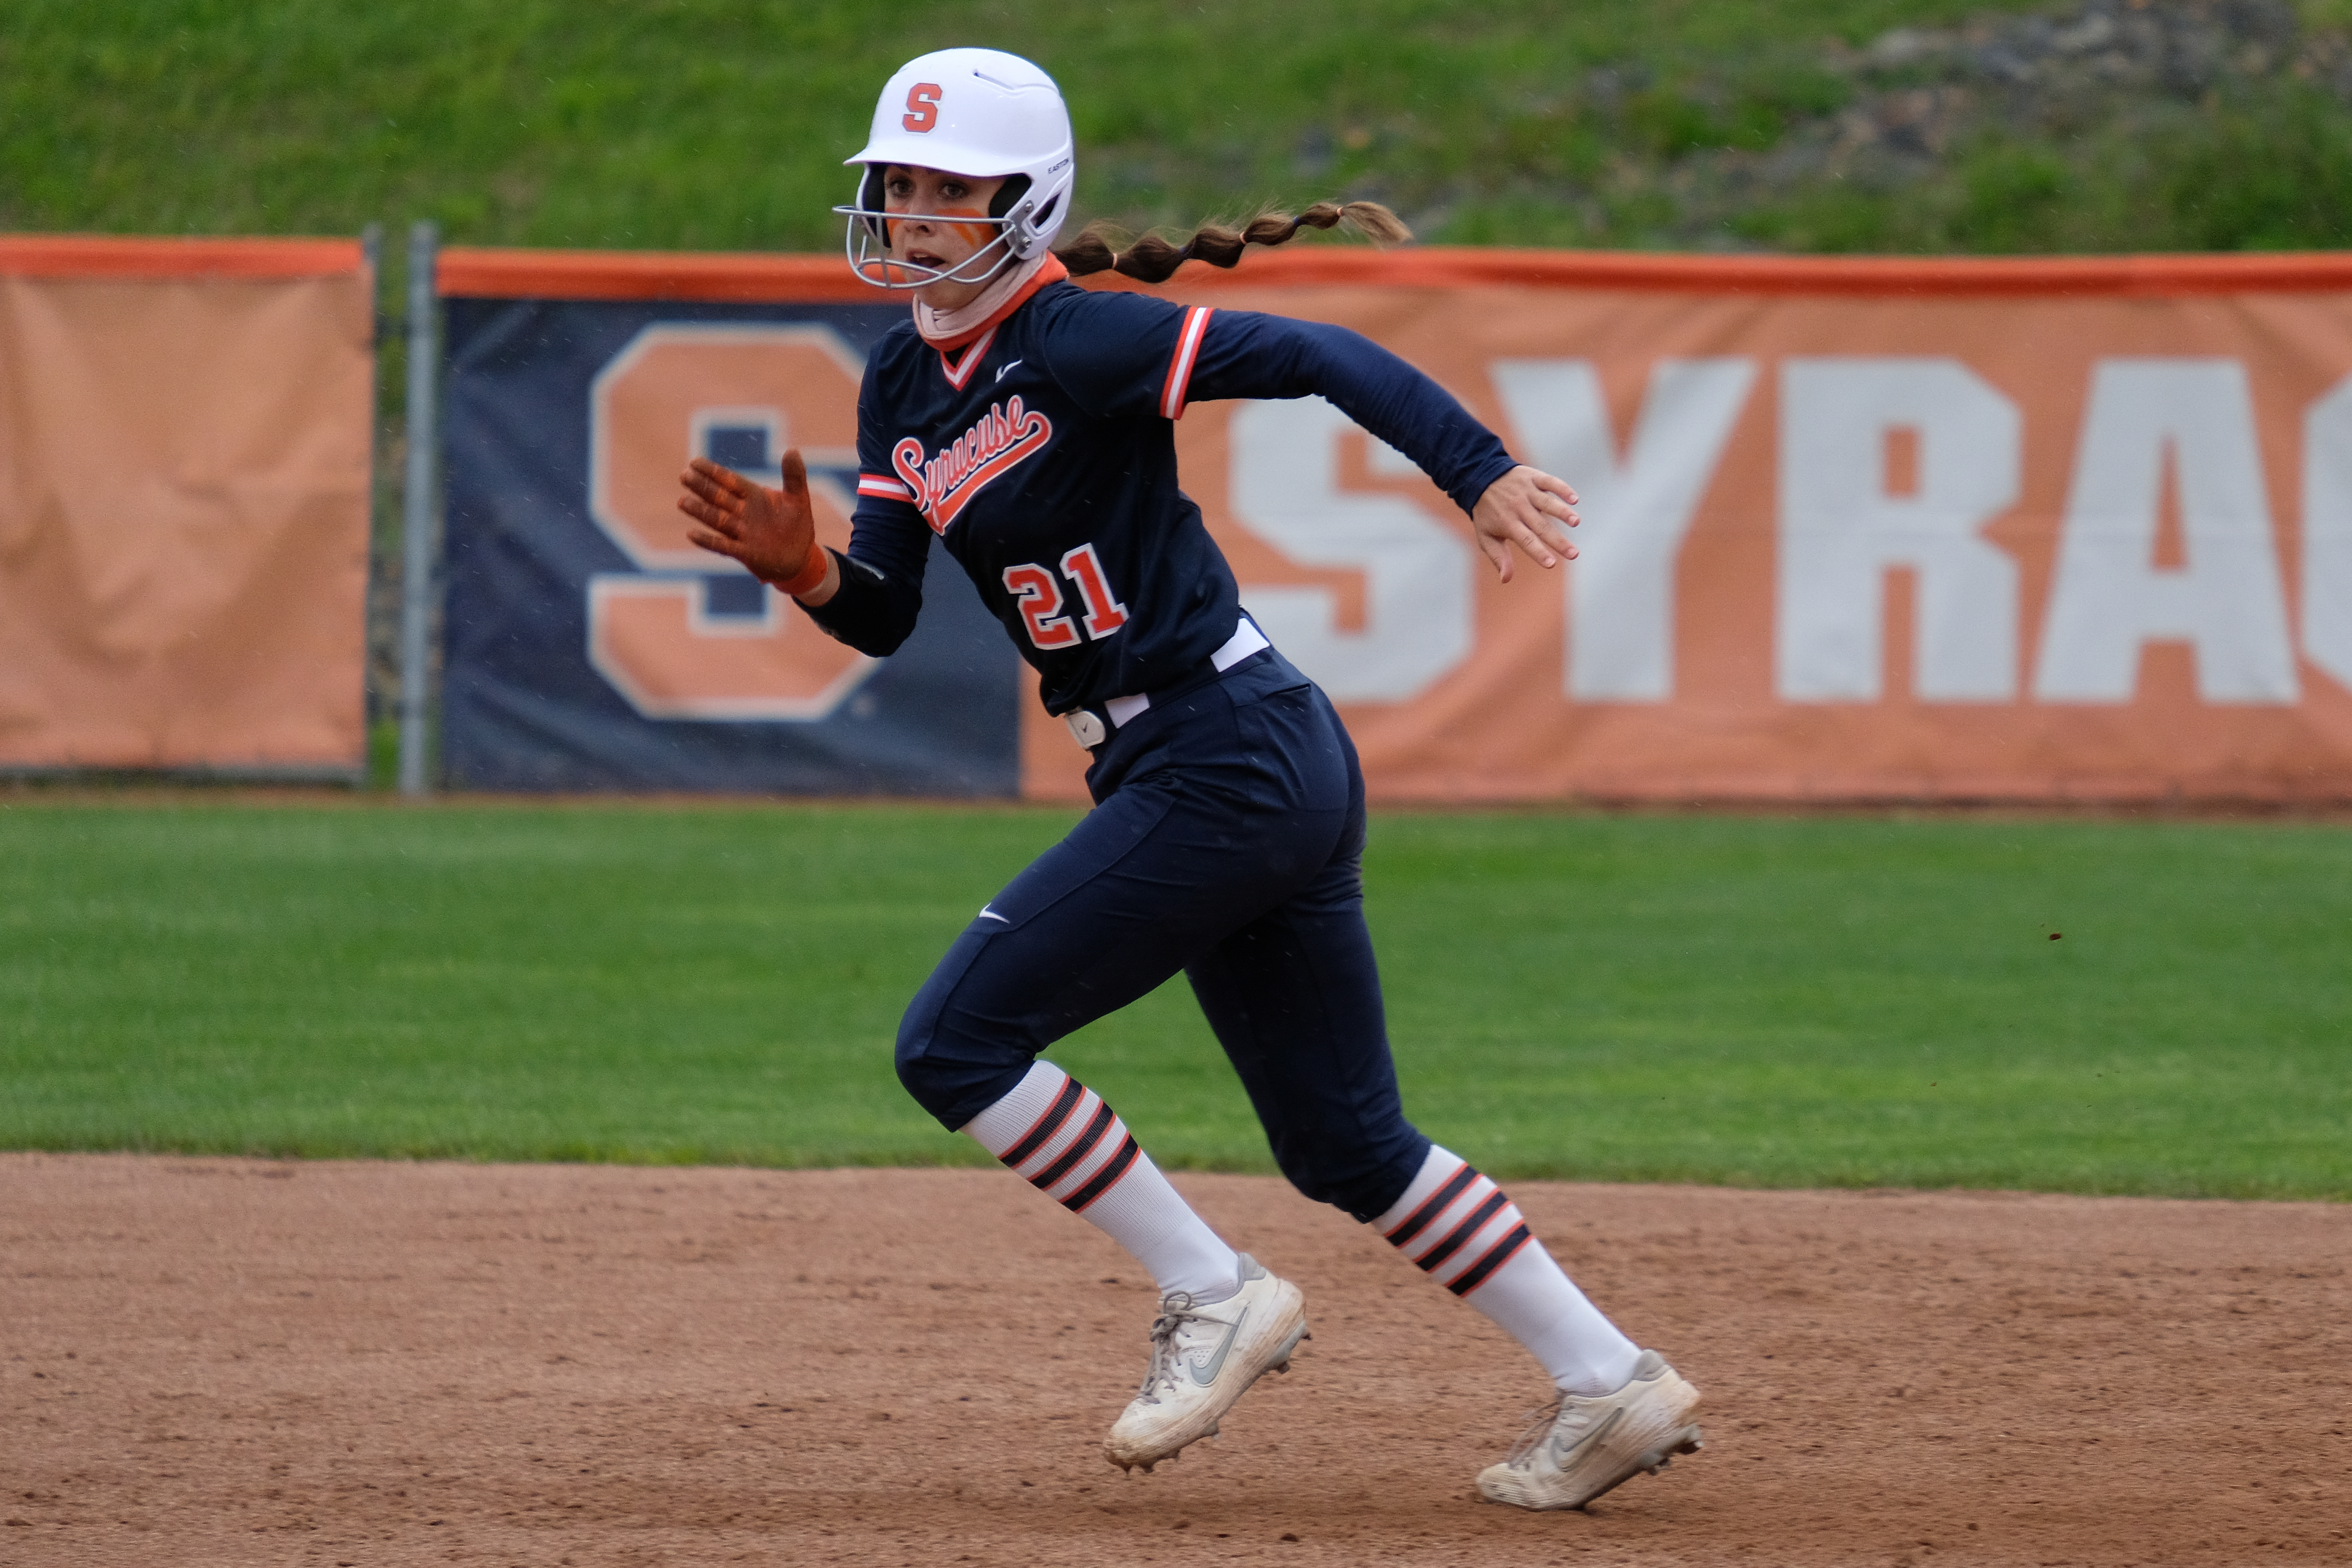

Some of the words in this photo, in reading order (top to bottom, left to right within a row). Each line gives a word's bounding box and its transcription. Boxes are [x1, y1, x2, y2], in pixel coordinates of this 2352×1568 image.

[901, 81, 943, 134] S
[588, 321, 882, 721] S
[891, 395, 1052, 536] Syracuse
[1227, 357, 2352, 703] SYRA
[1002, 542, 1130, 650] 21
